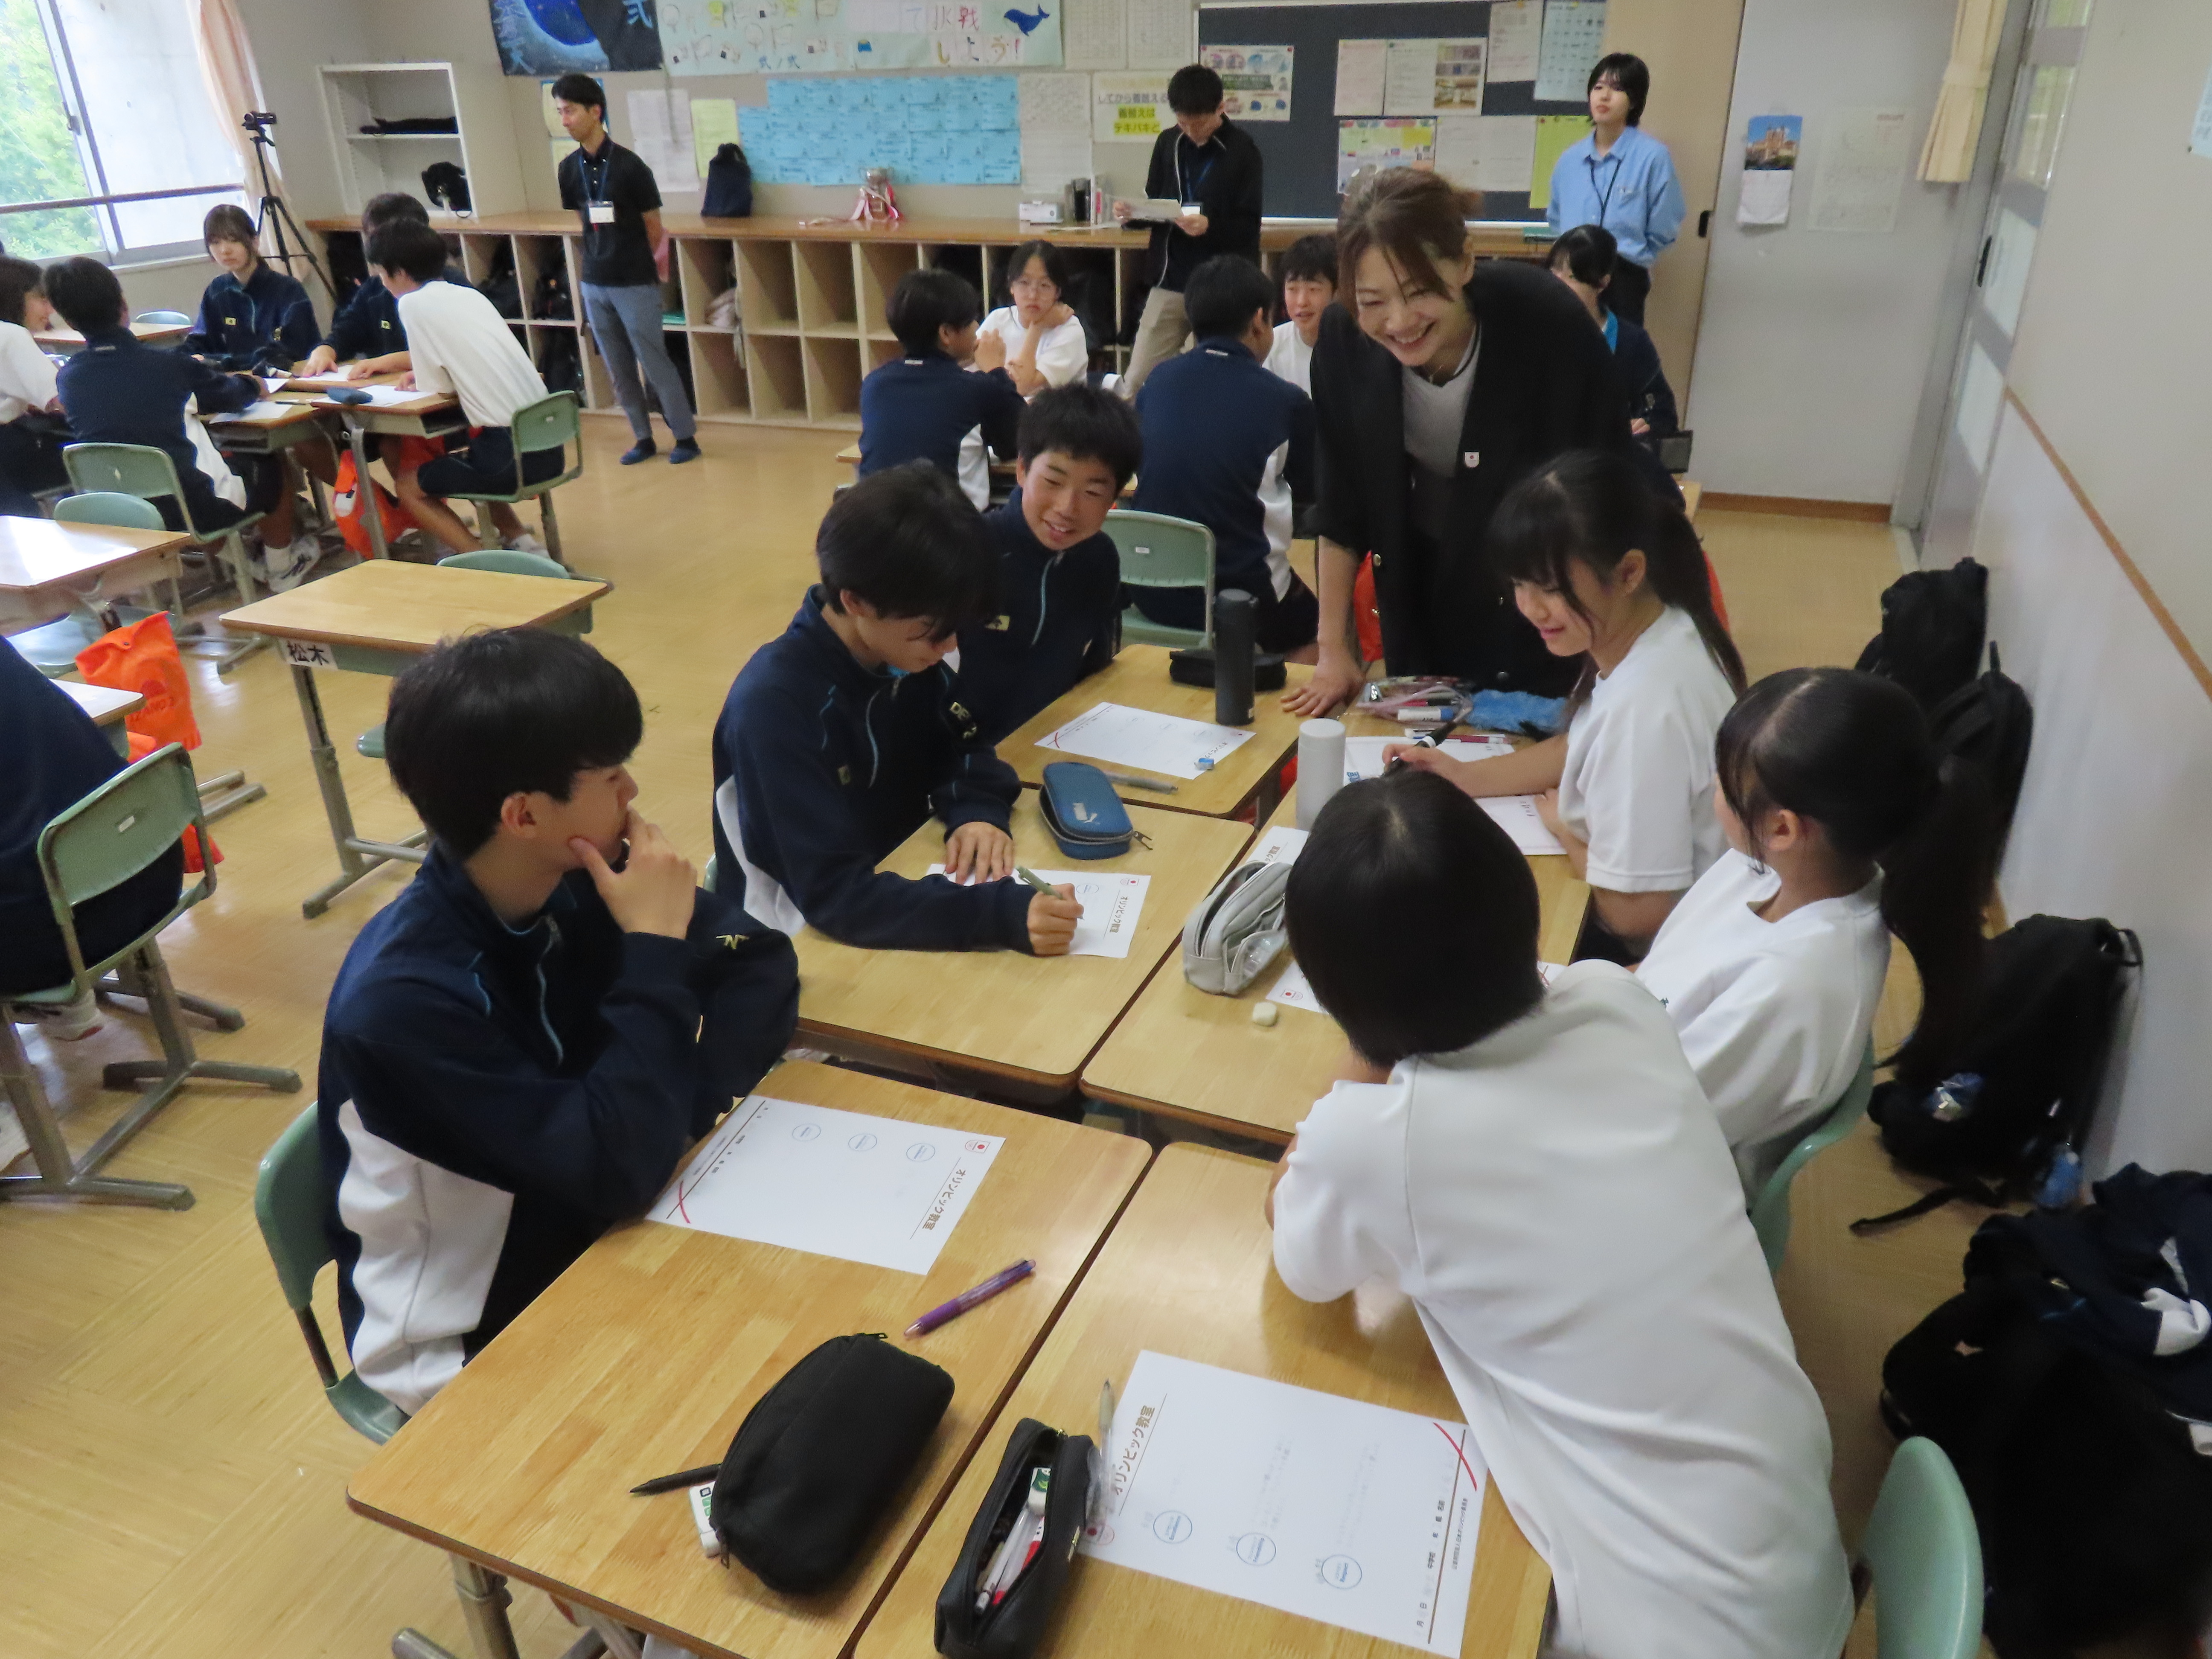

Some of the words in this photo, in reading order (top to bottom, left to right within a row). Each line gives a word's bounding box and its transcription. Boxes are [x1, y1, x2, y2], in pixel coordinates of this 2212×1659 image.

[1109, 896, 1129, 933] オリンピック教室
[922, 1169, 966, 1231] オリンピック教室
[1115, 1405, 1155, 1496] オリンピック教室
